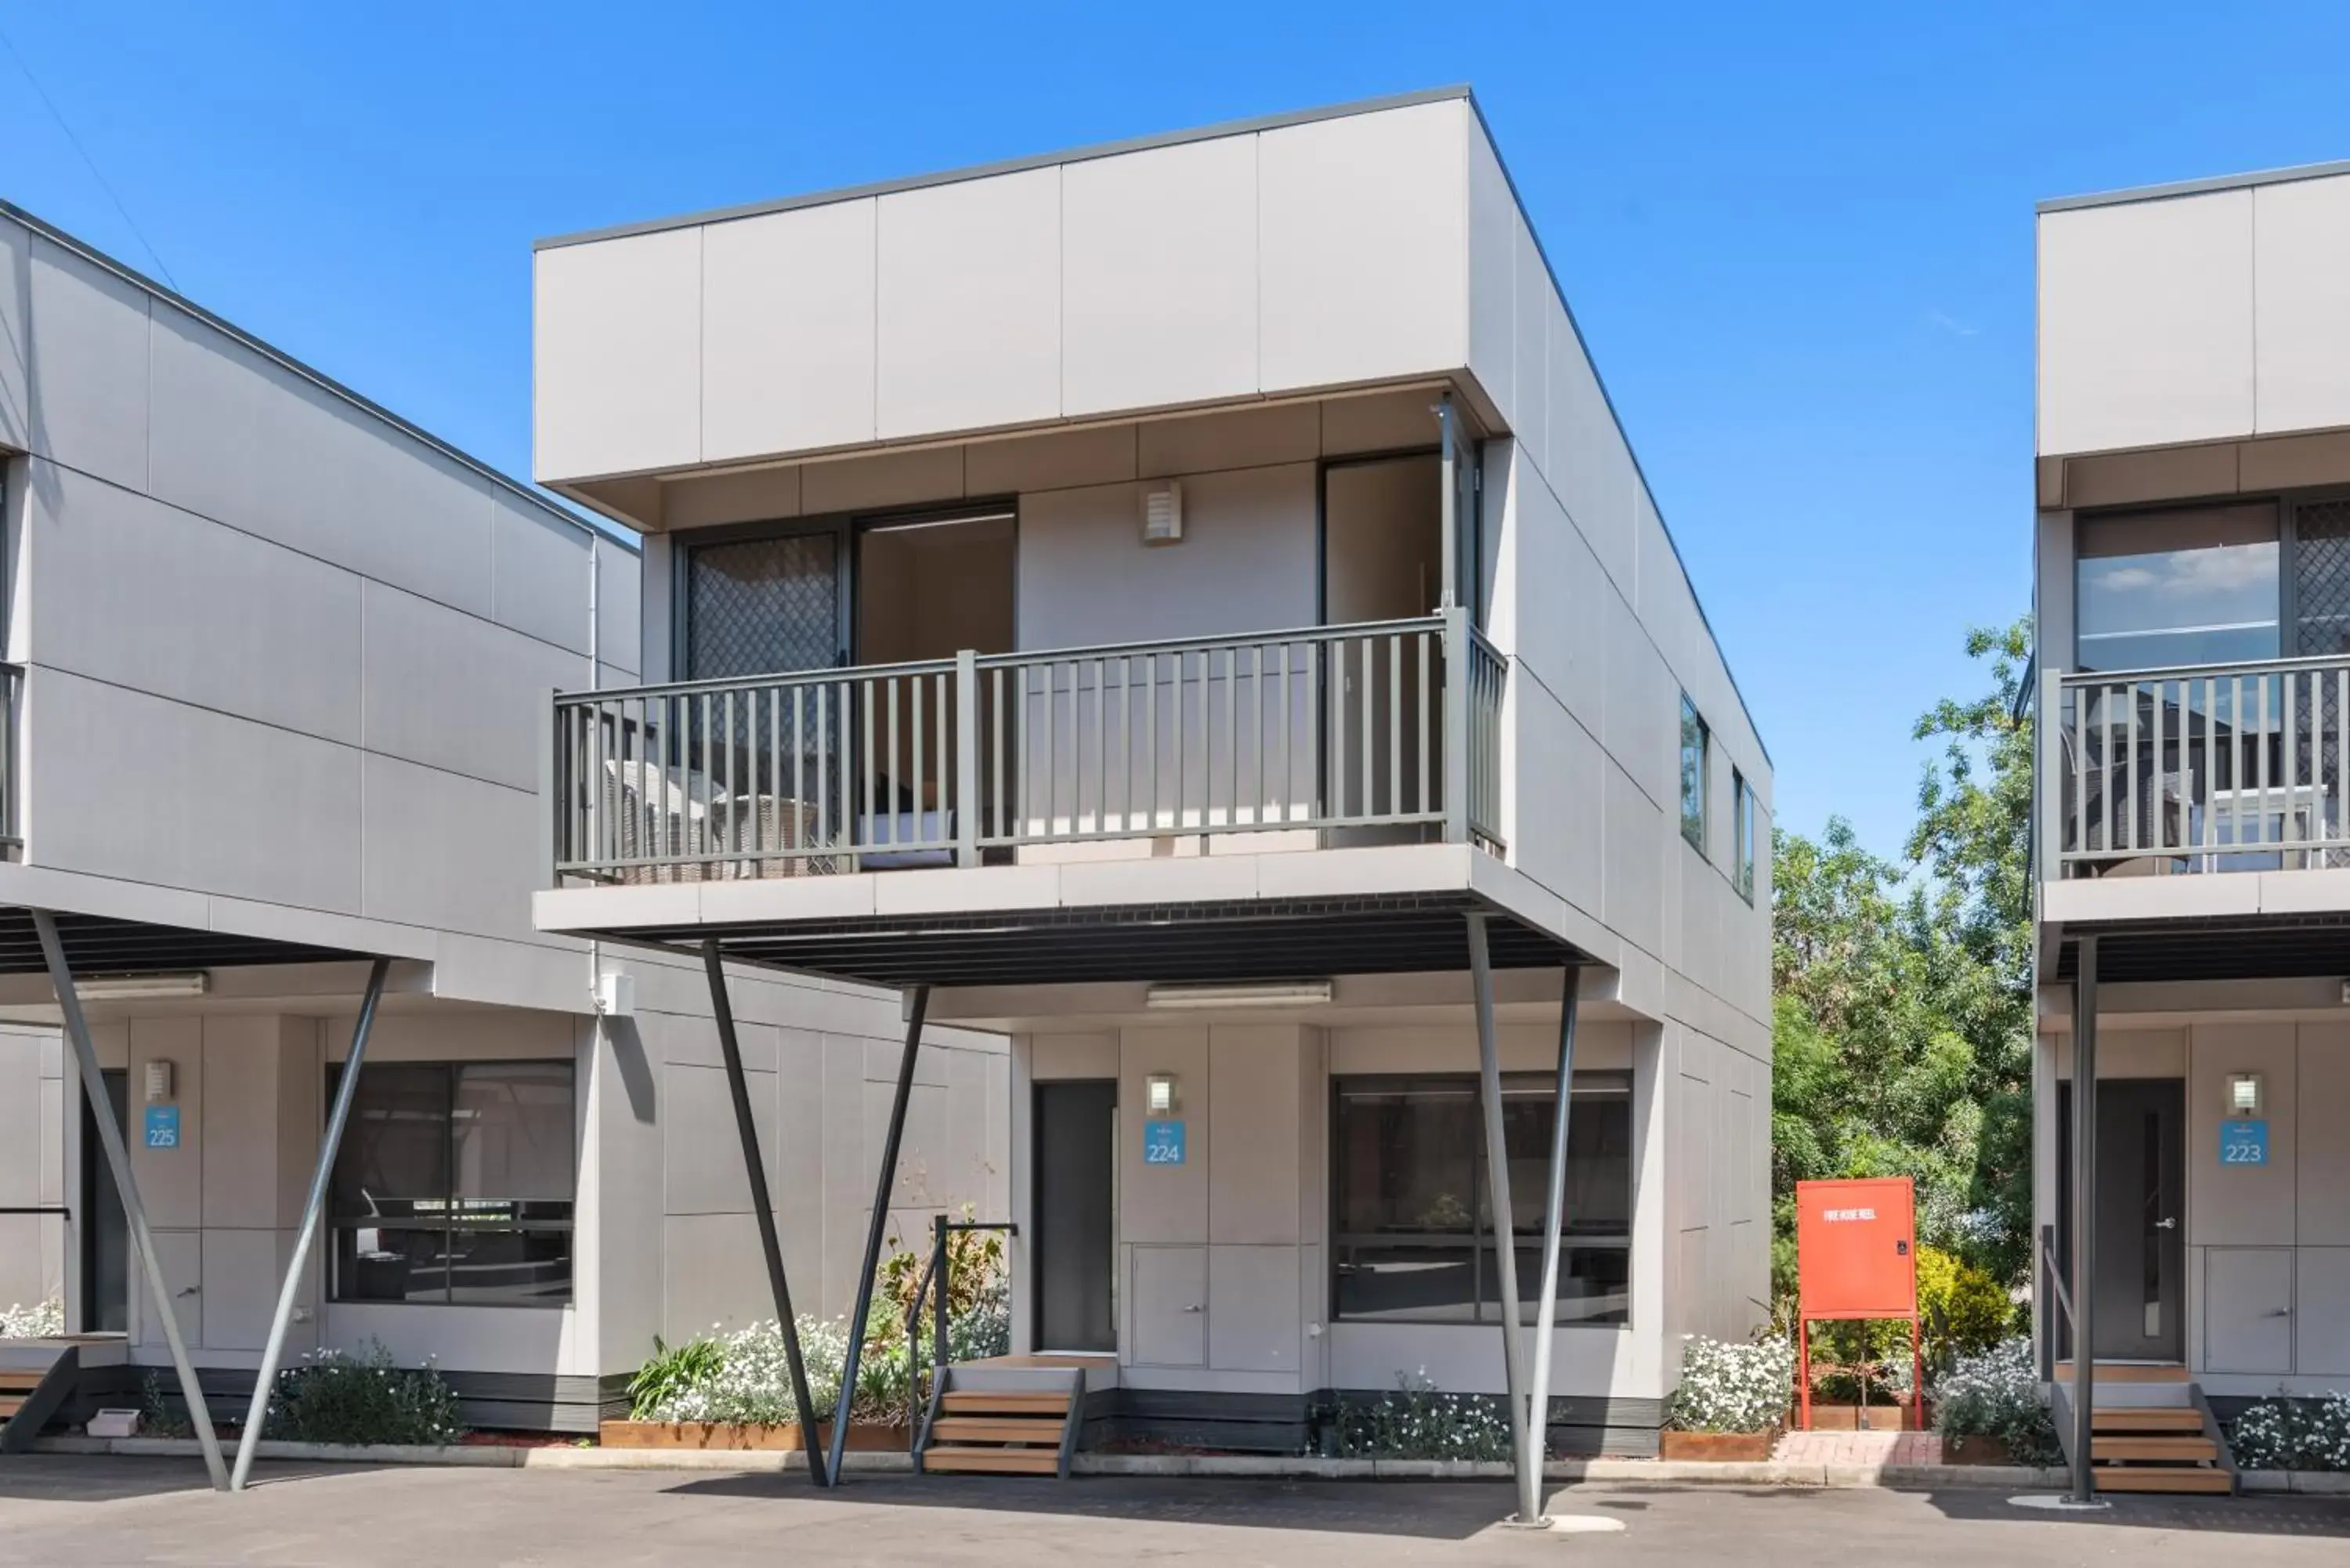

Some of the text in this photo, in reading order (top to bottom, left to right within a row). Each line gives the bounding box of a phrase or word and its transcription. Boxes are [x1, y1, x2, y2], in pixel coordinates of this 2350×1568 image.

[150, 1129, 175, 1146] 225
[1148, 1143, 1179, 1162] 224
[2225, 1143, 2261, 1162] 223
